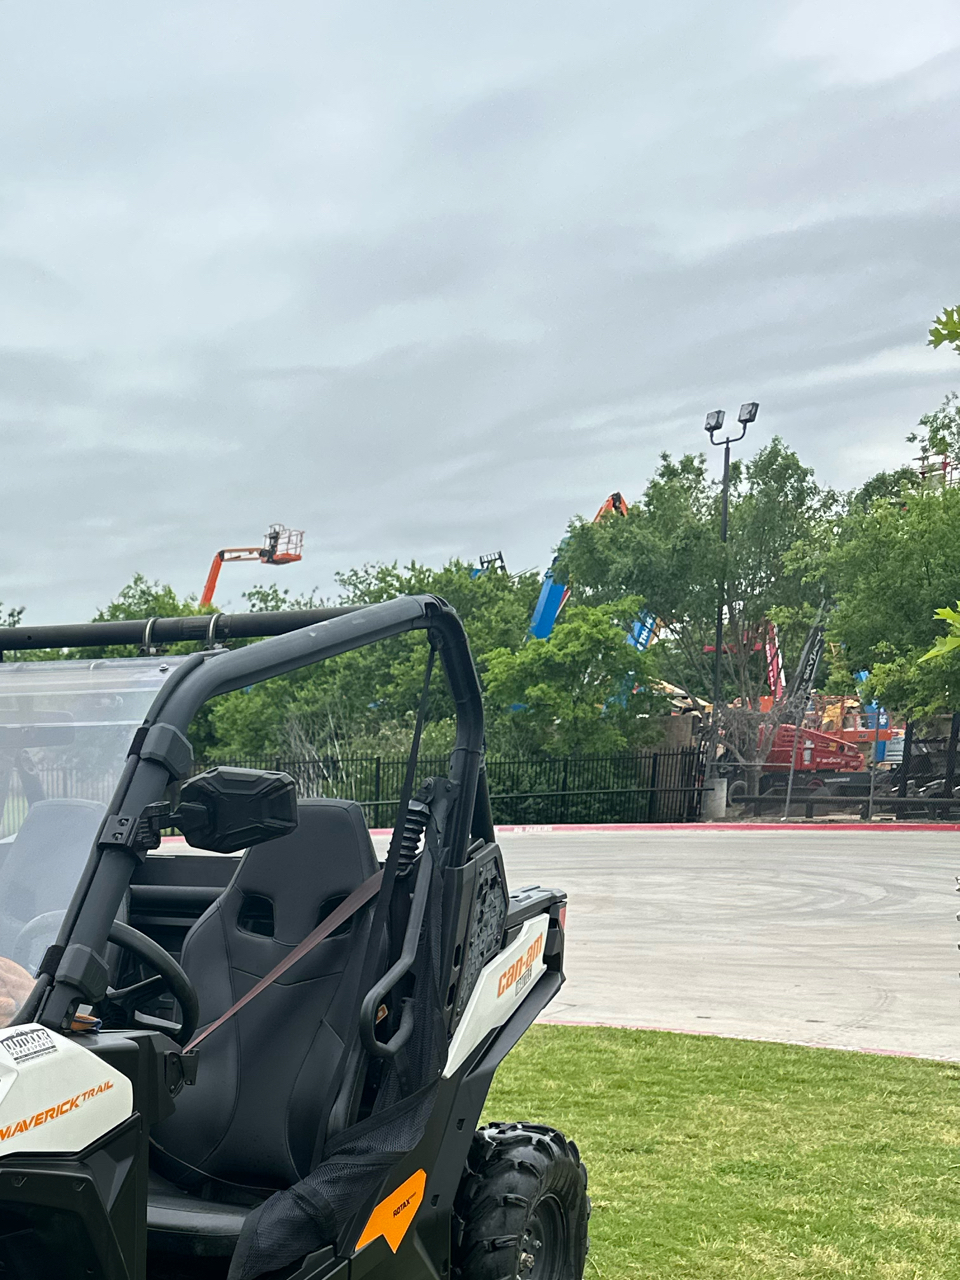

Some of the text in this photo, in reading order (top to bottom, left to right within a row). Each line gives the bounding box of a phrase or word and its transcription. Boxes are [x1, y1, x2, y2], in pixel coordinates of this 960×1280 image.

[497, 932, 543, 999] can-am
[3, 1030, 52, 1051] OUTDOOR
[10, 1040, 54, 1057] POWERSPORTS
[81, 1080, 114, 1101] TRAIL
[393, 1198, 411, 1218] ROTAX
